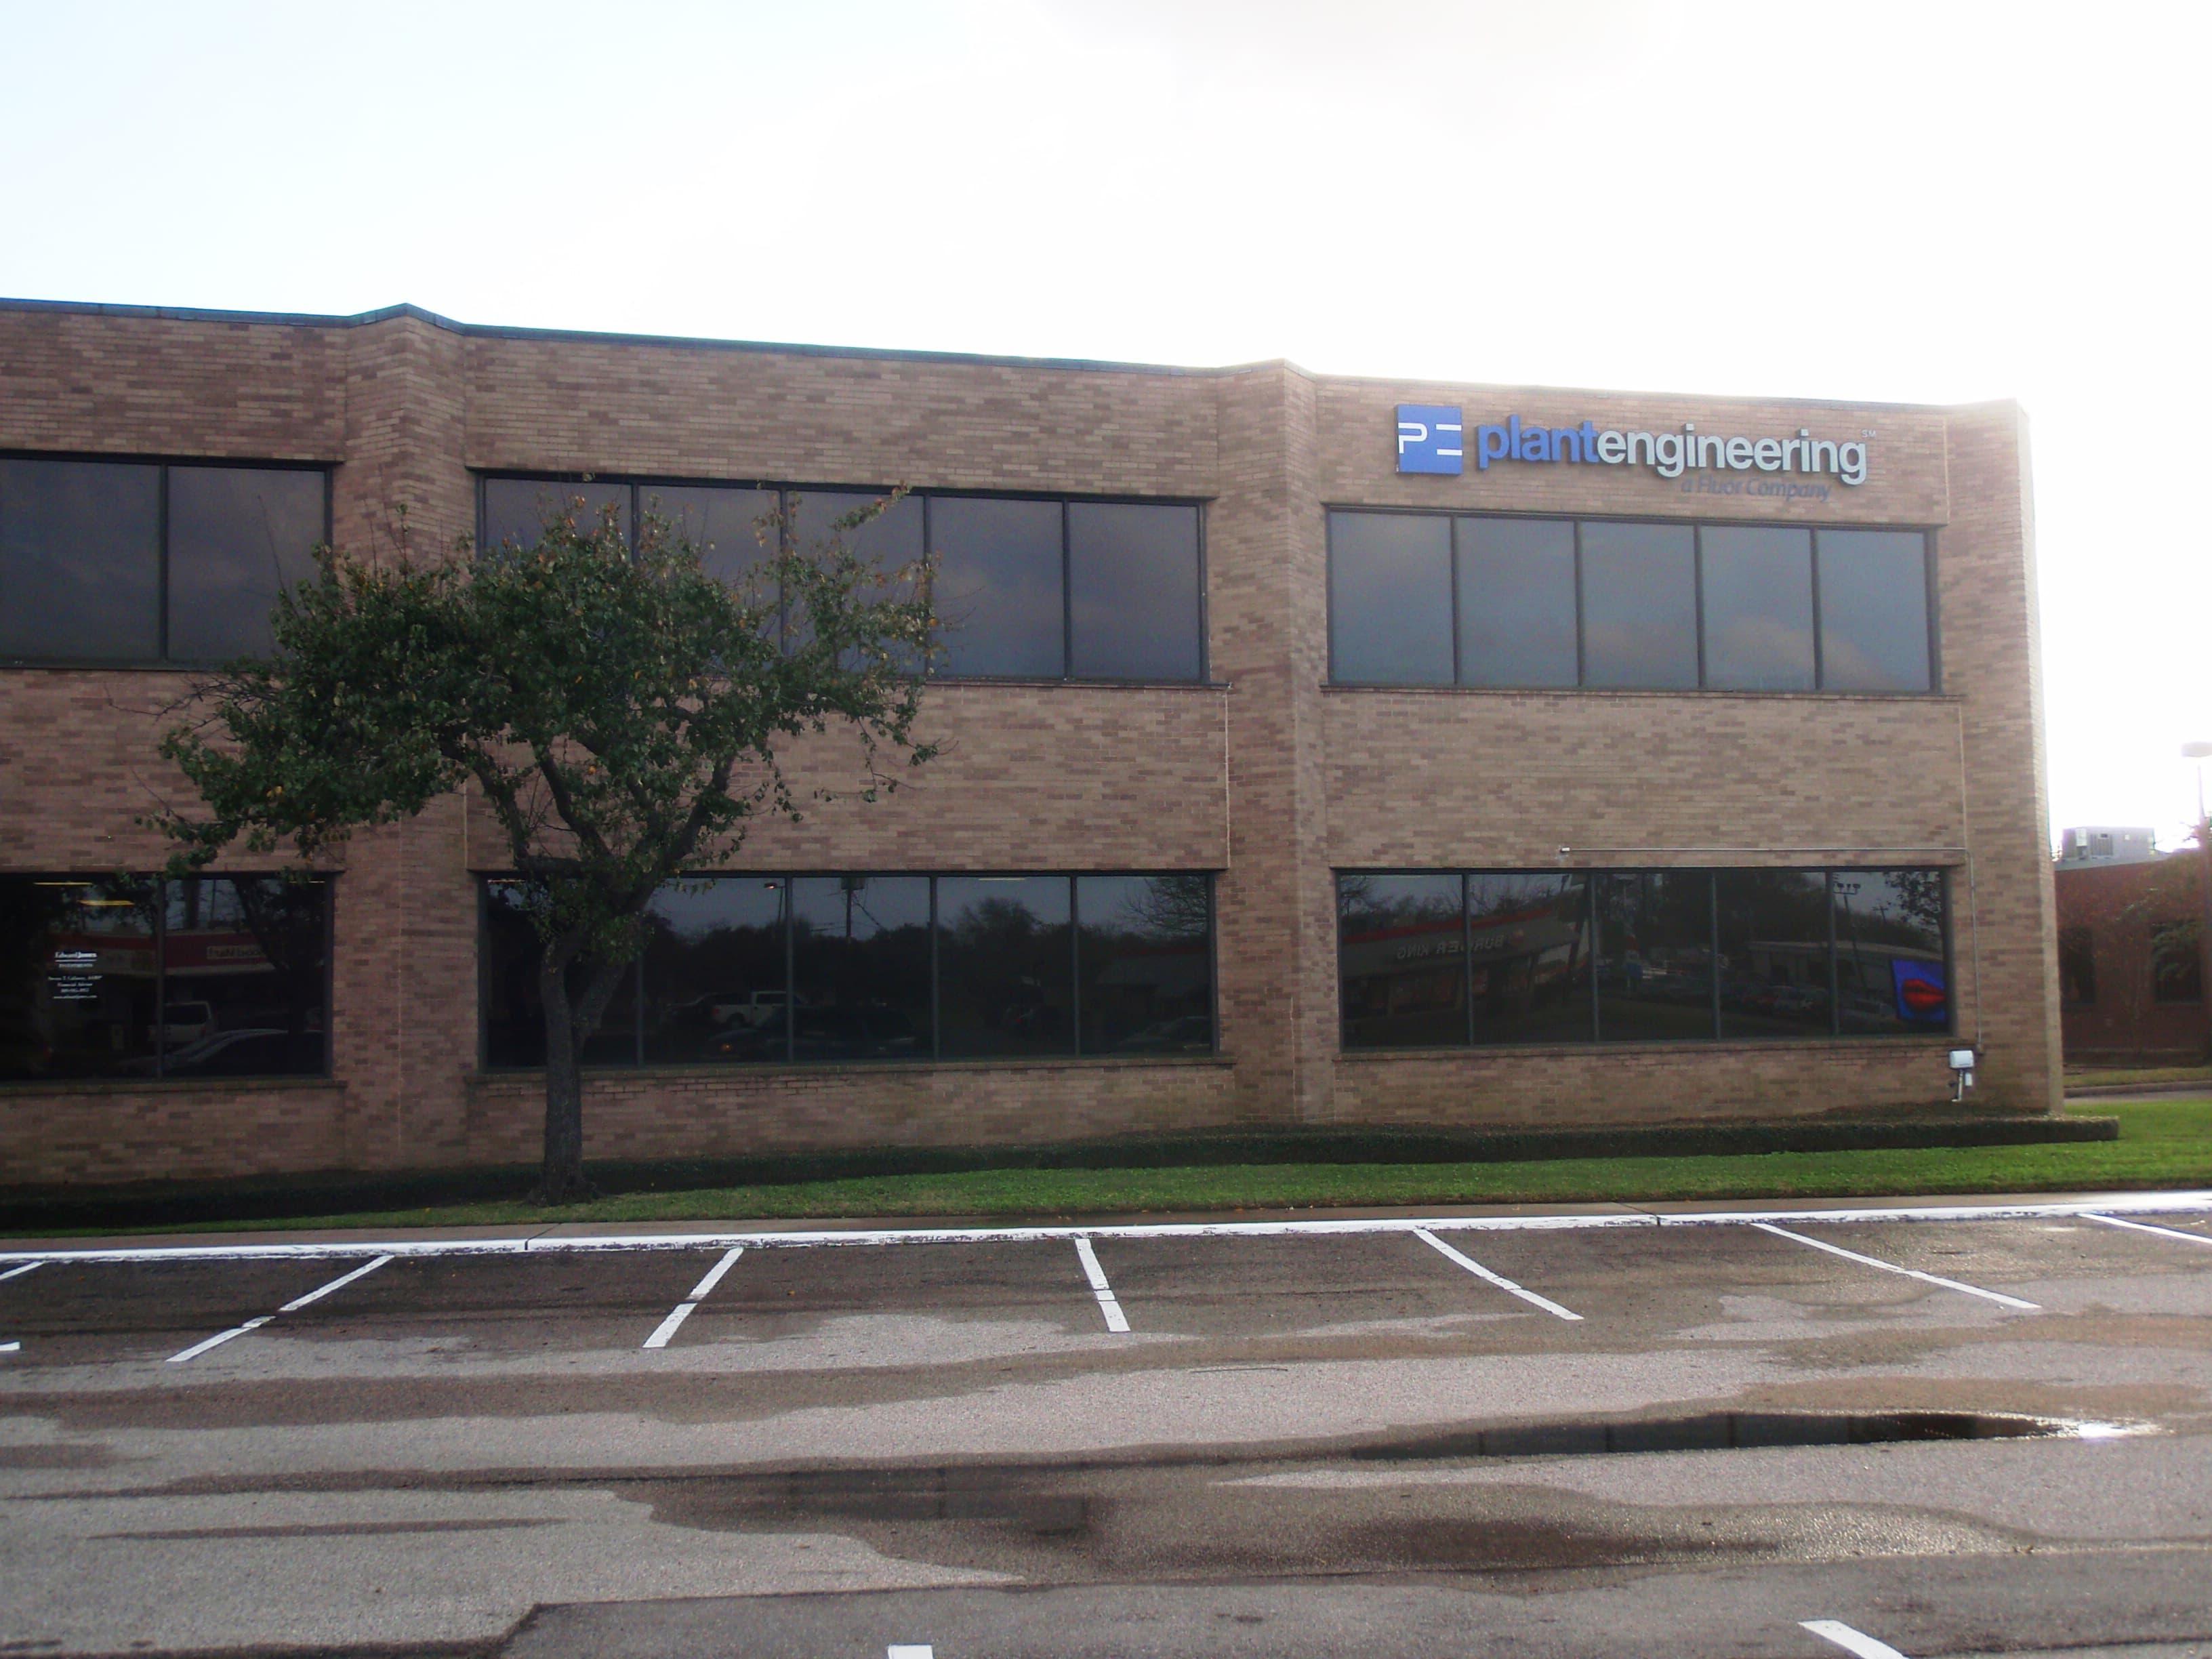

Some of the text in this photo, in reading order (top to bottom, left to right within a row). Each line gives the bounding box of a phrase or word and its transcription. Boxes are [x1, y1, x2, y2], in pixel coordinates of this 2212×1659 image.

[1681, 476, 1830, 502] a Fluor Company
